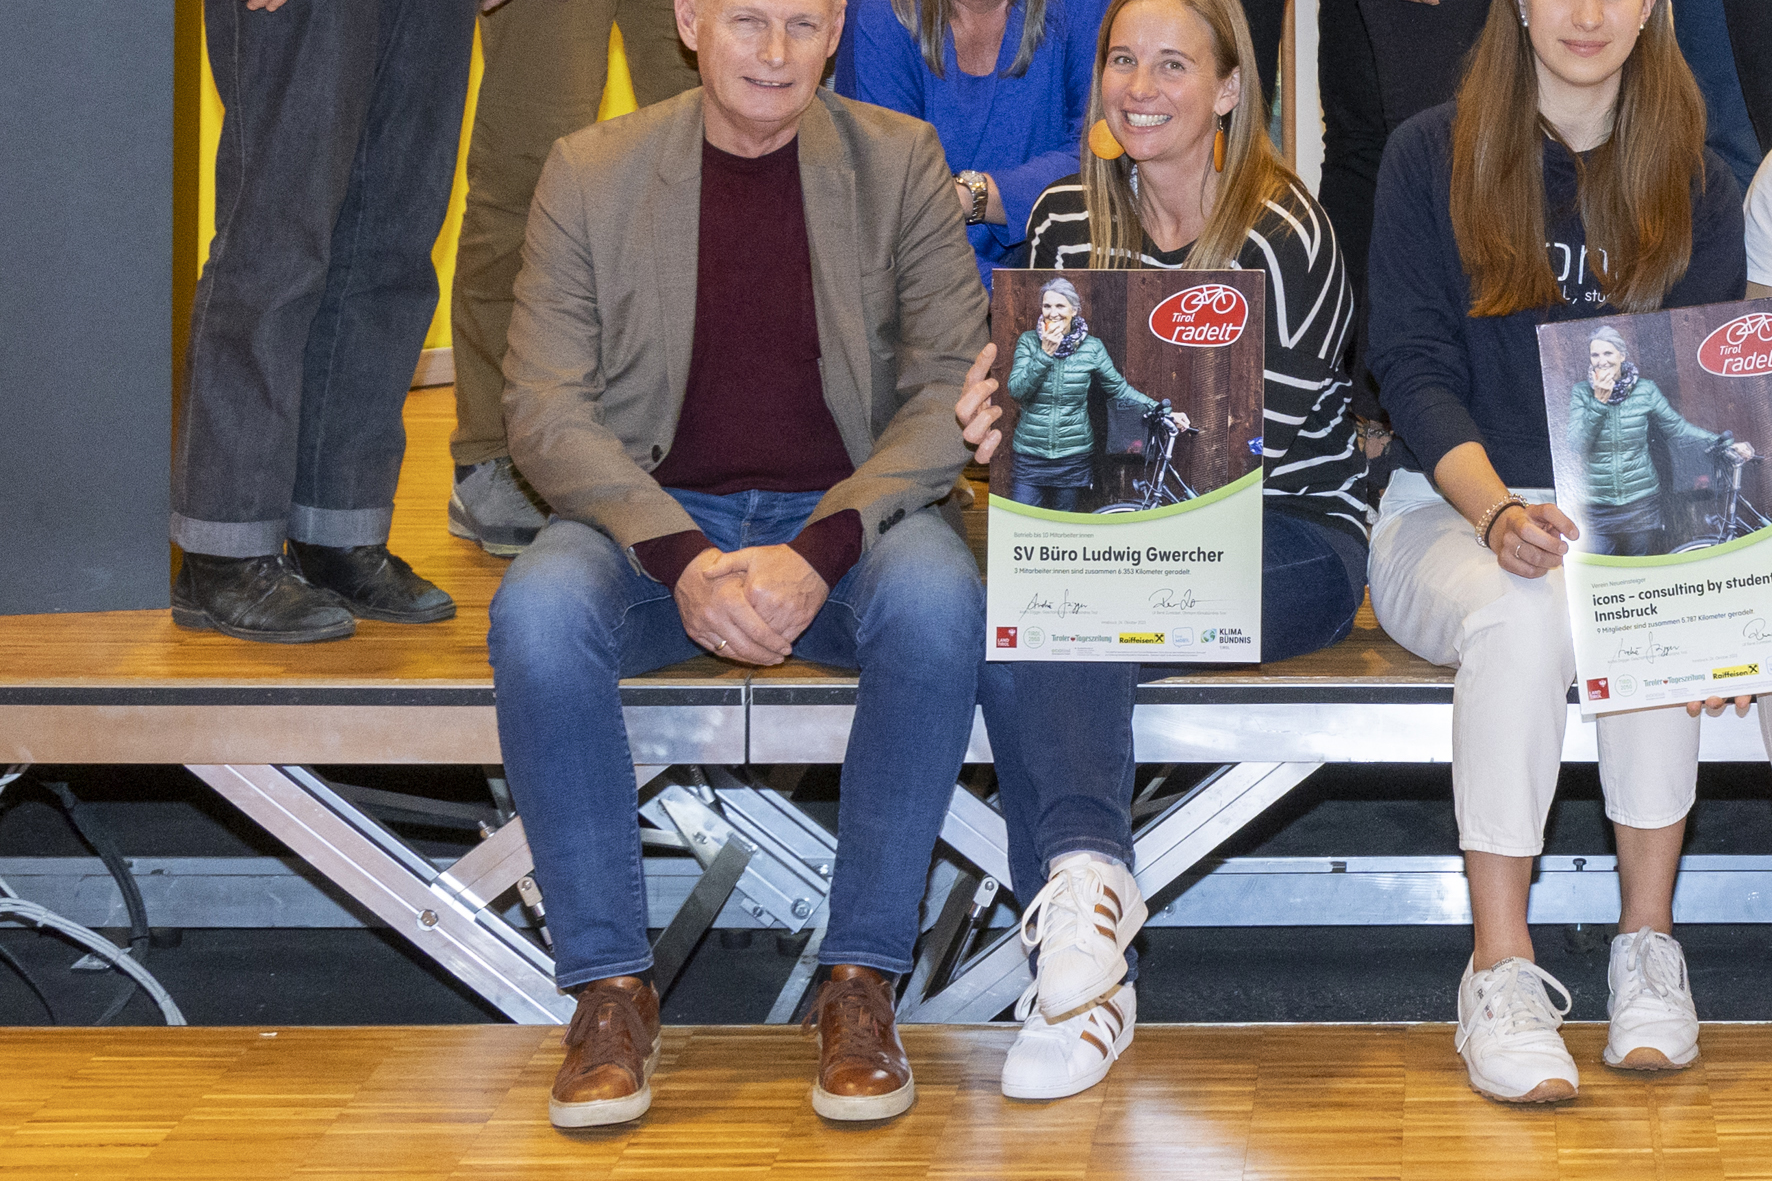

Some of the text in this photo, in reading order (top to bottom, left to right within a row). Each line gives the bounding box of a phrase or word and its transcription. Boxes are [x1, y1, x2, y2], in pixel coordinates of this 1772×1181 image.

[1172, 313, 1195, 322] Tirol
[1172, 323, 1234, 341] radelt
[1720, 344, 1742, 355] Tirol
[1013, 546, 1224, 566] SV Büro Ludwig Gwercher
[1591, 581, 1608, 589] Verein
[1593, 593, 1625, 606] icons
[1638, 583, 1704, 600] consulting
[1707, 579, 1722, 593] by
[1595, 603, 1658, 622] Innsbruck
[1602, 624, 1632, 634] Mitglieder
[1634, 622, 1647, 630] sind
[1648, 619, 1680, 629] zusammen
[1698, 612, 1726, 621] Kilometer
[1728, 608, 1754, 619] geradelt.
[1075, 635, 1112, 643] Tageszeitung
[1644, 674, 1705, 687] Tiroler Tageszeitung
[1713, 670, 1748, 679] Raiffeisen
